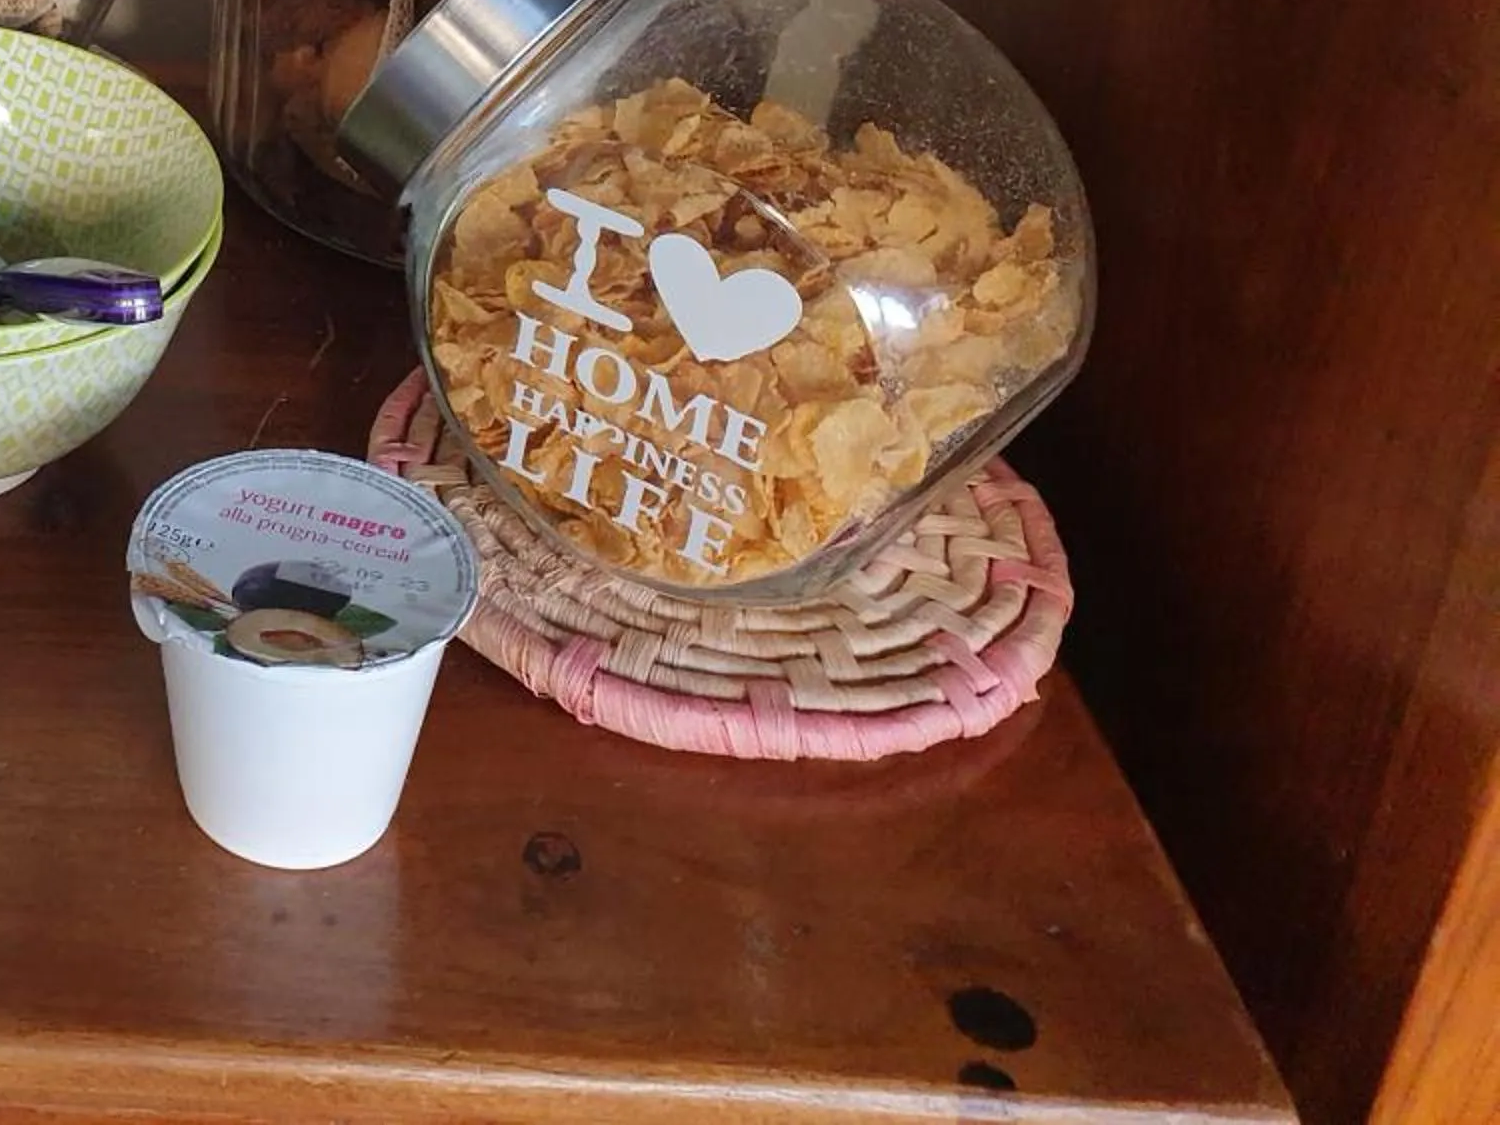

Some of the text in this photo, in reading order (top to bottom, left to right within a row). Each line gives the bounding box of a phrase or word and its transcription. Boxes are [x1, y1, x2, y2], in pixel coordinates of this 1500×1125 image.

[531, 188, 645, 332] I
[509, 311, 768, 472] HOME
[218, 506, 412, 564] alla prugna-cereali
[236, 488, 407, 540] yogurt magro
[499, 416, 734, 575] LIFE
